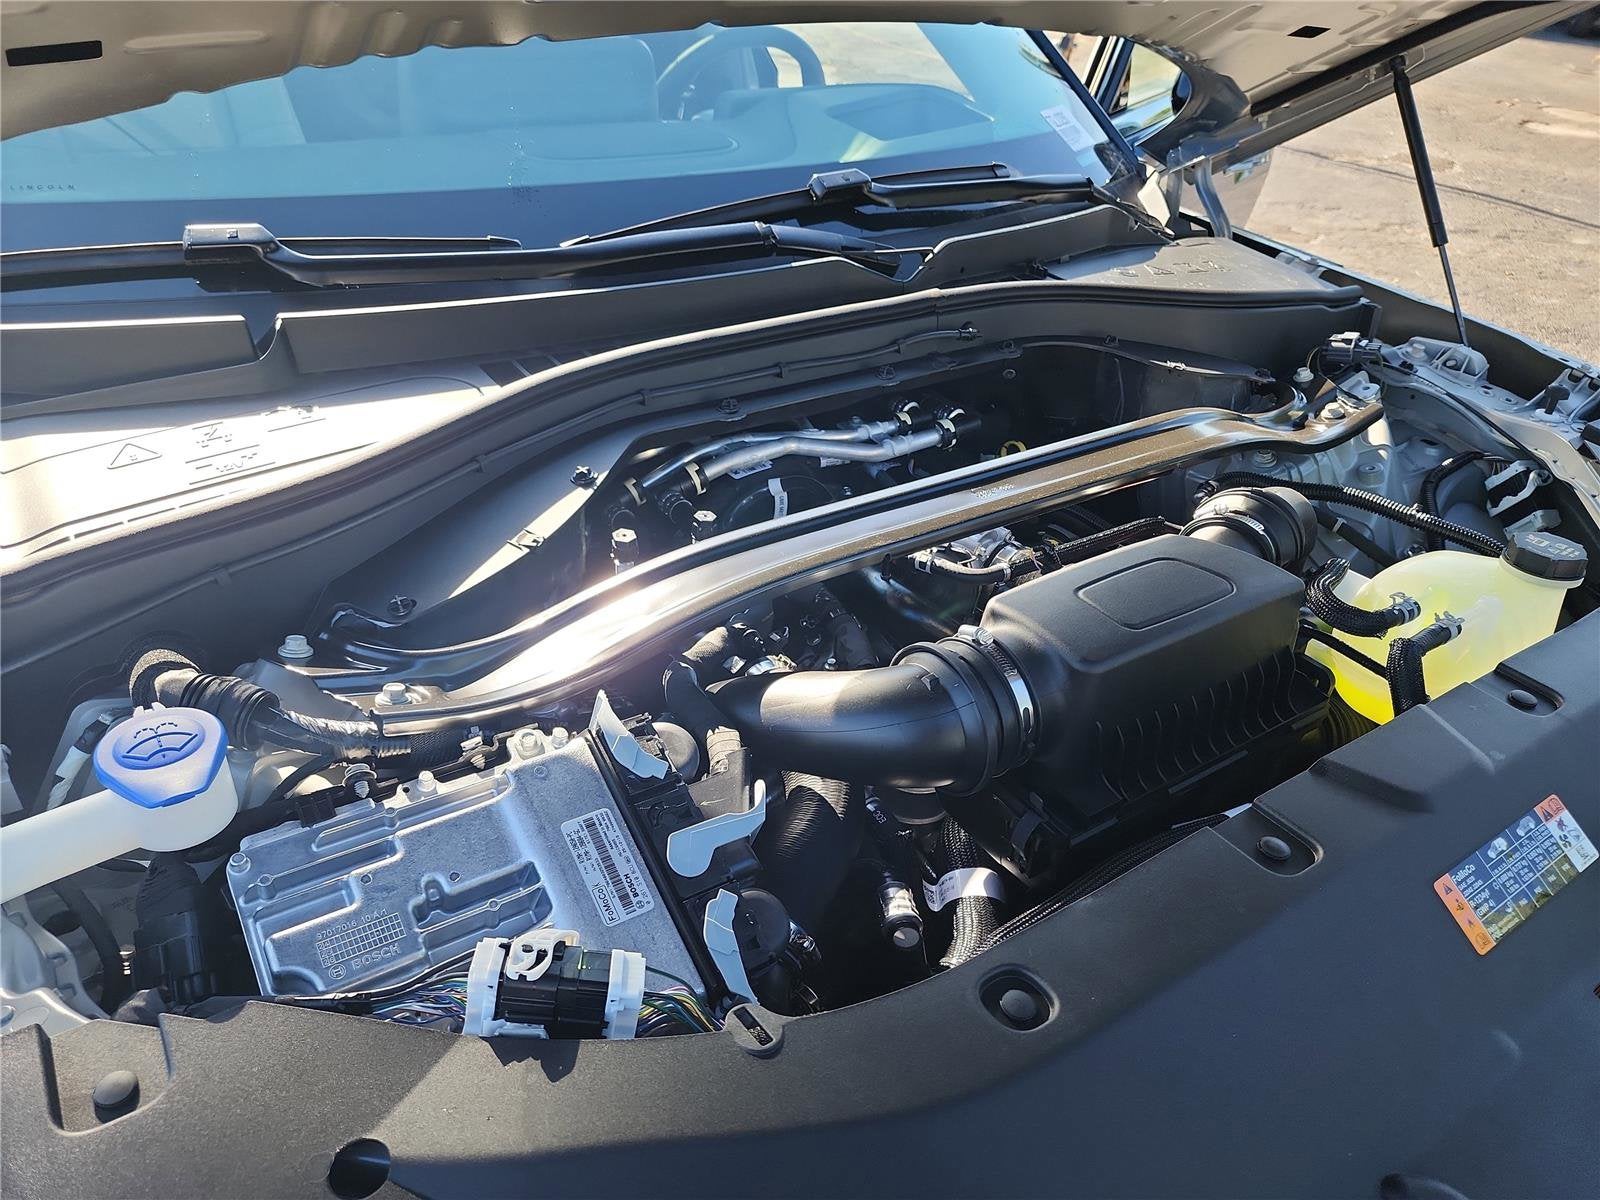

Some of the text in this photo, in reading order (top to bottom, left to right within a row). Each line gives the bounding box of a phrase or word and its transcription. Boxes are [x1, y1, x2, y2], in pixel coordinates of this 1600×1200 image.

[9, 184, 76, 192] LINCOLN
[1452, 864, 1476, 884] FoMoCo
[624, 873, 638, 898] BOSCH
[596, 888, 616, 922] FoMoCo
[1469, 888, 1490, 908] R-1234yf
[1476, 902, 1490, 918] (GWP
[352, 942, 401, 970] BOSCH
